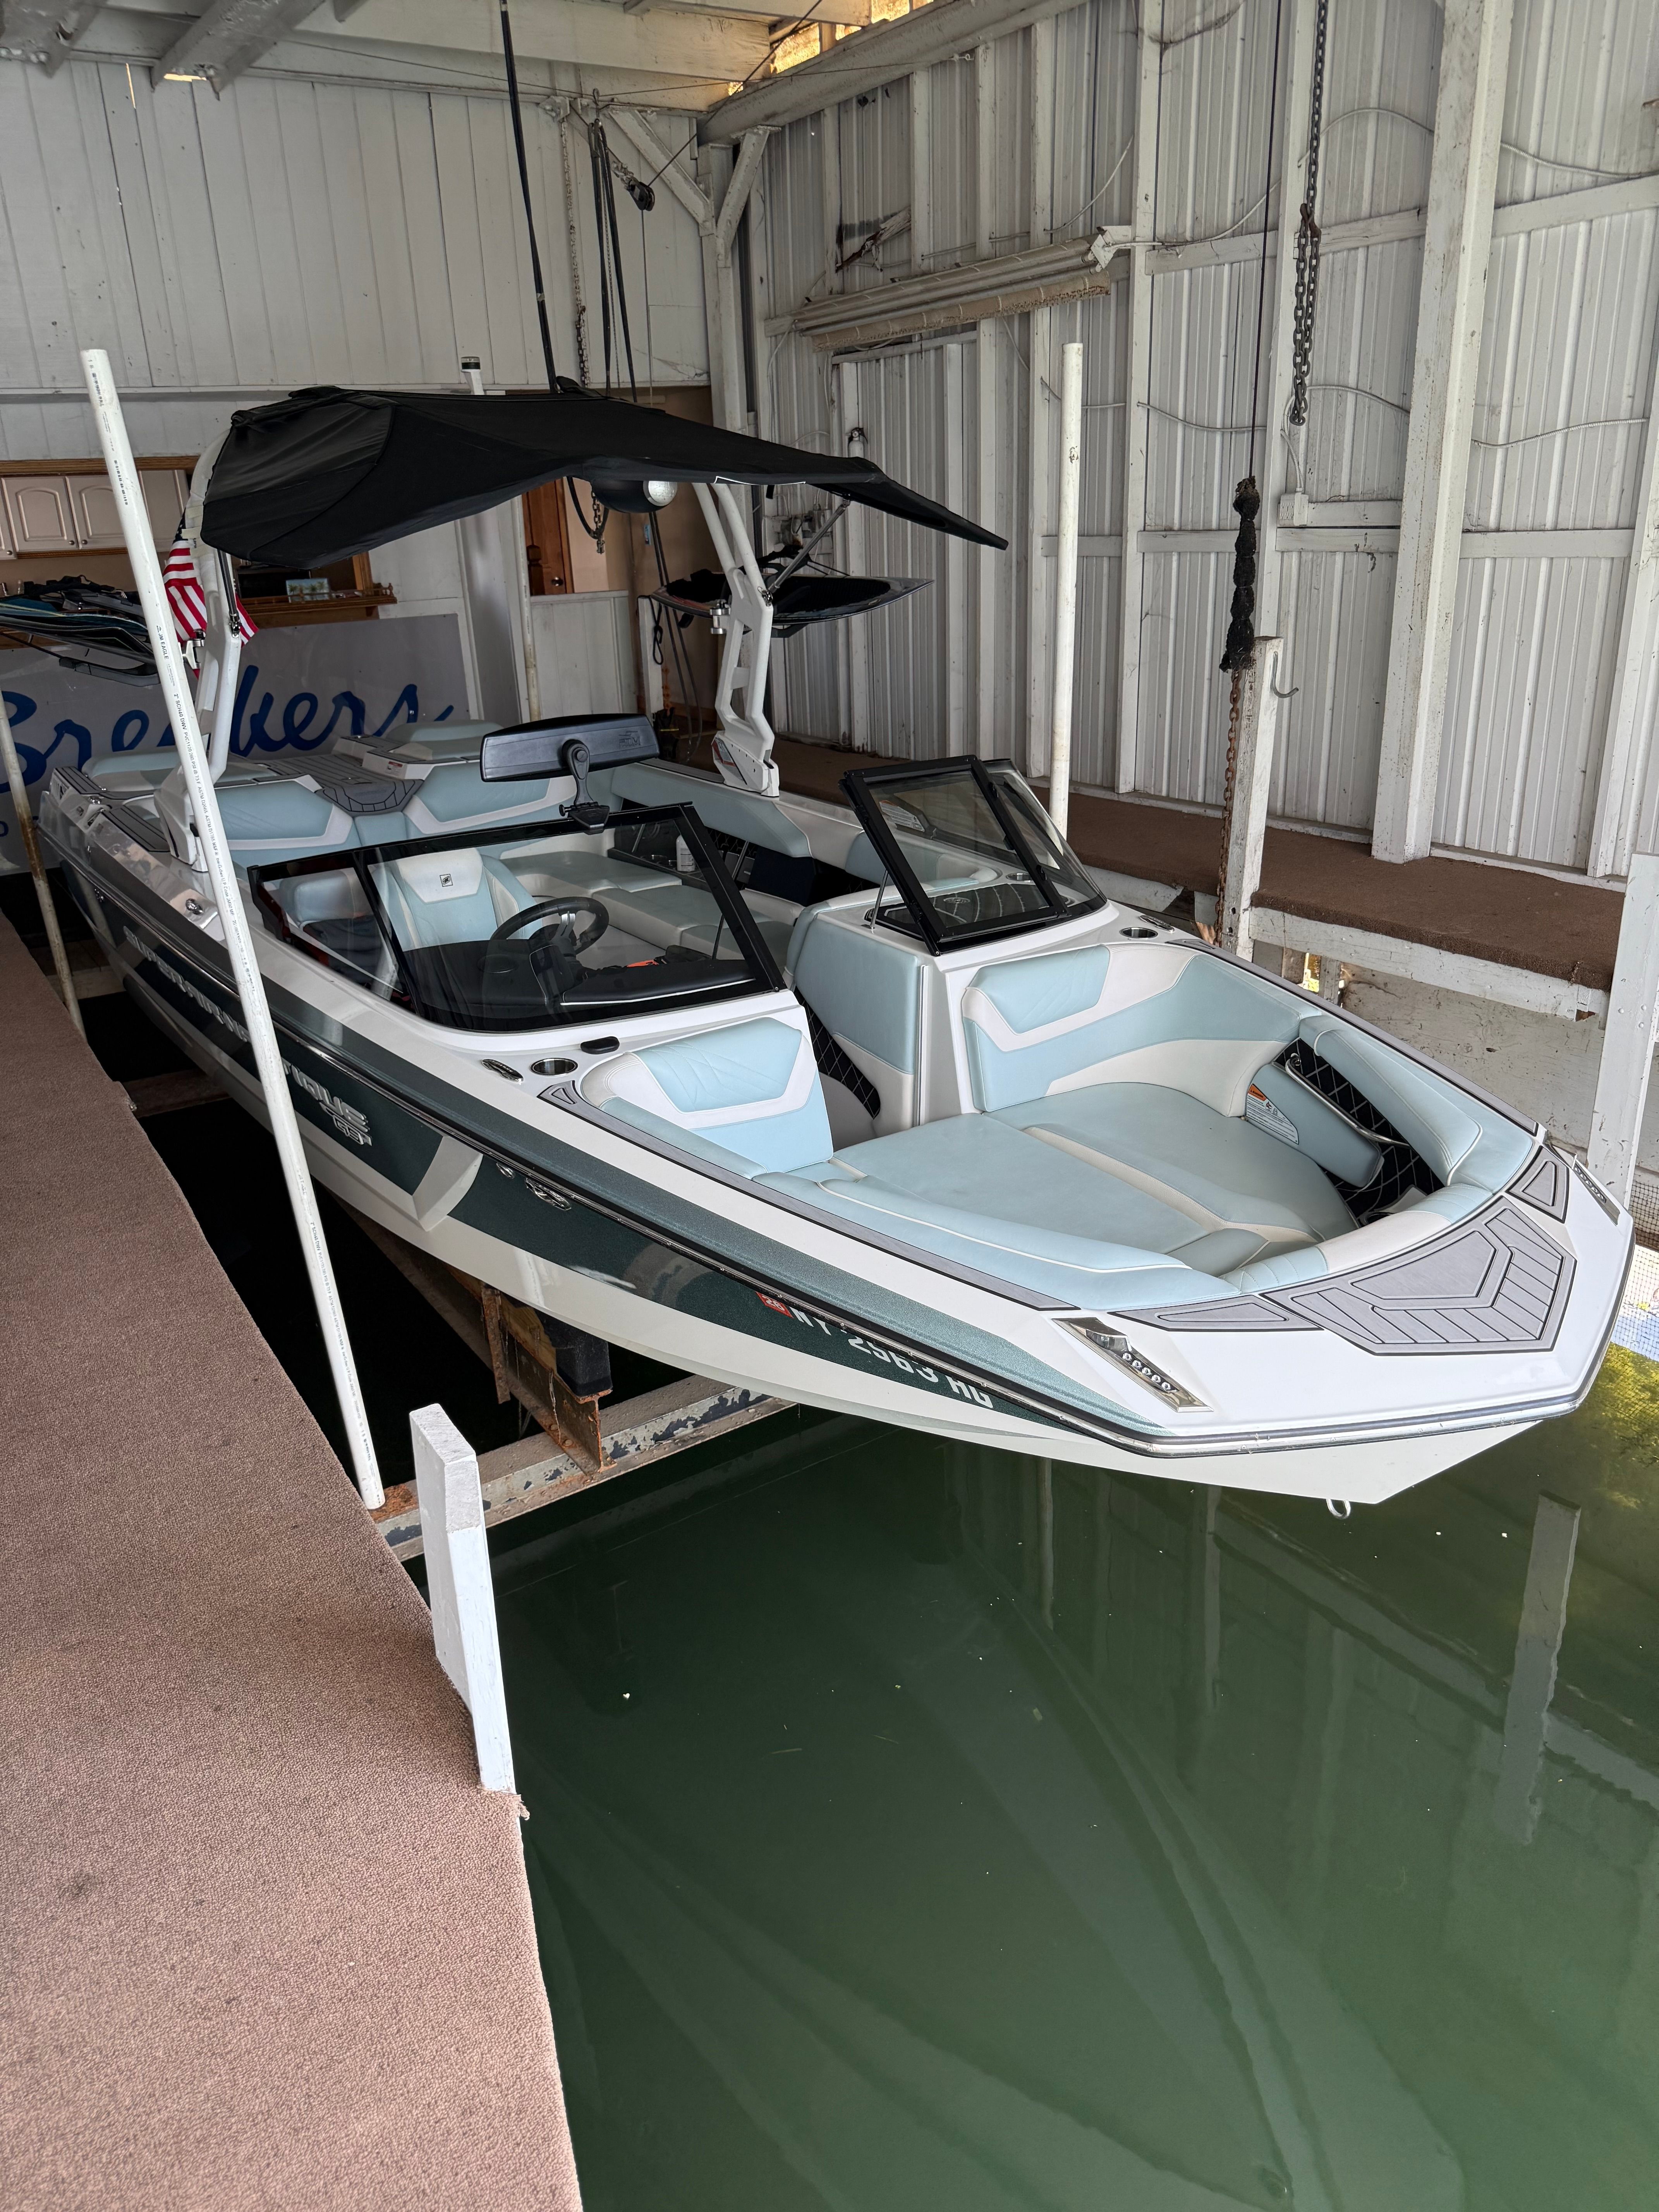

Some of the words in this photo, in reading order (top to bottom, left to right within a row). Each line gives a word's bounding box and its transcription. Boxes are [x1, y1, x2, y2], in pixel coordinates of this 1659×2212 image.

[158, 632, 164, 641] JM
[160, 641, 168, 659] EAGLE
[0, 665, 454, 794] Brekers
[222, 1011, 368, 1132] NATIQUE
[762, 1295, 785, 1311] 26
[789, 1306, 832, 1336] NY
[841, 1329, 939, 1382] 2563
[945, 1375, 993, 1408] HG
